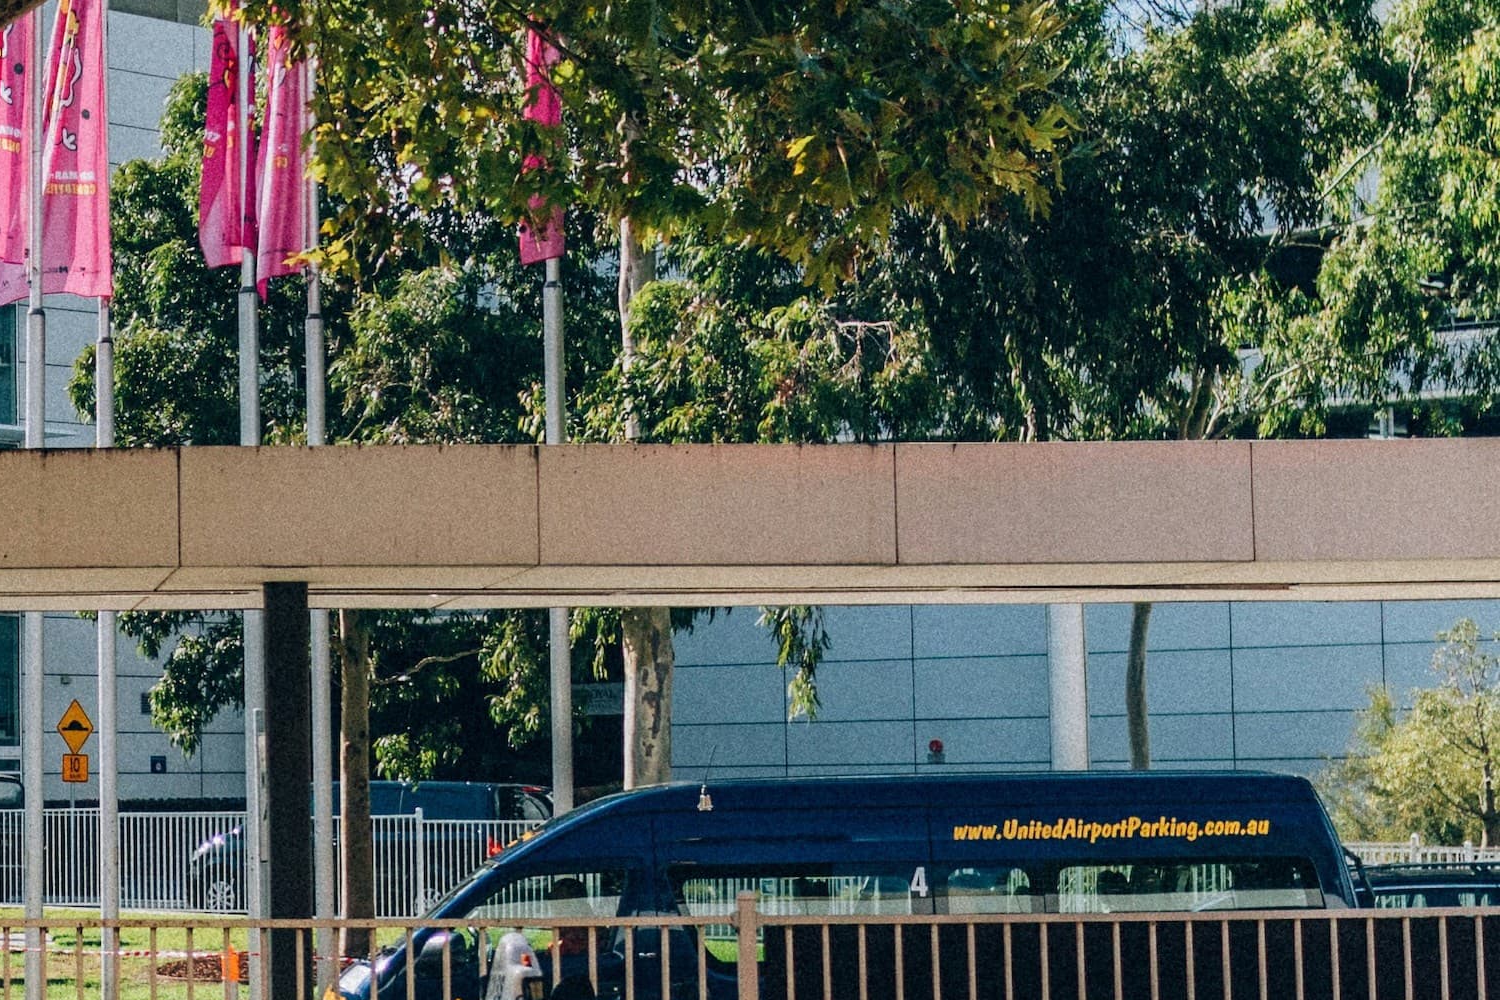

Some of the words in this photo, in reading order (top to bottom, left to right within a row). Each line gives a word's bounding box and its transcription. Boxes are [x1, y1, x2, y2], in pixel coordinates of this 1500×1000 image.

[70, 757, 80, 772] 10
[953, 816, 1270, 843] www.UnitedAirportParking.com.au
[910, 866, 929, 897] 4
